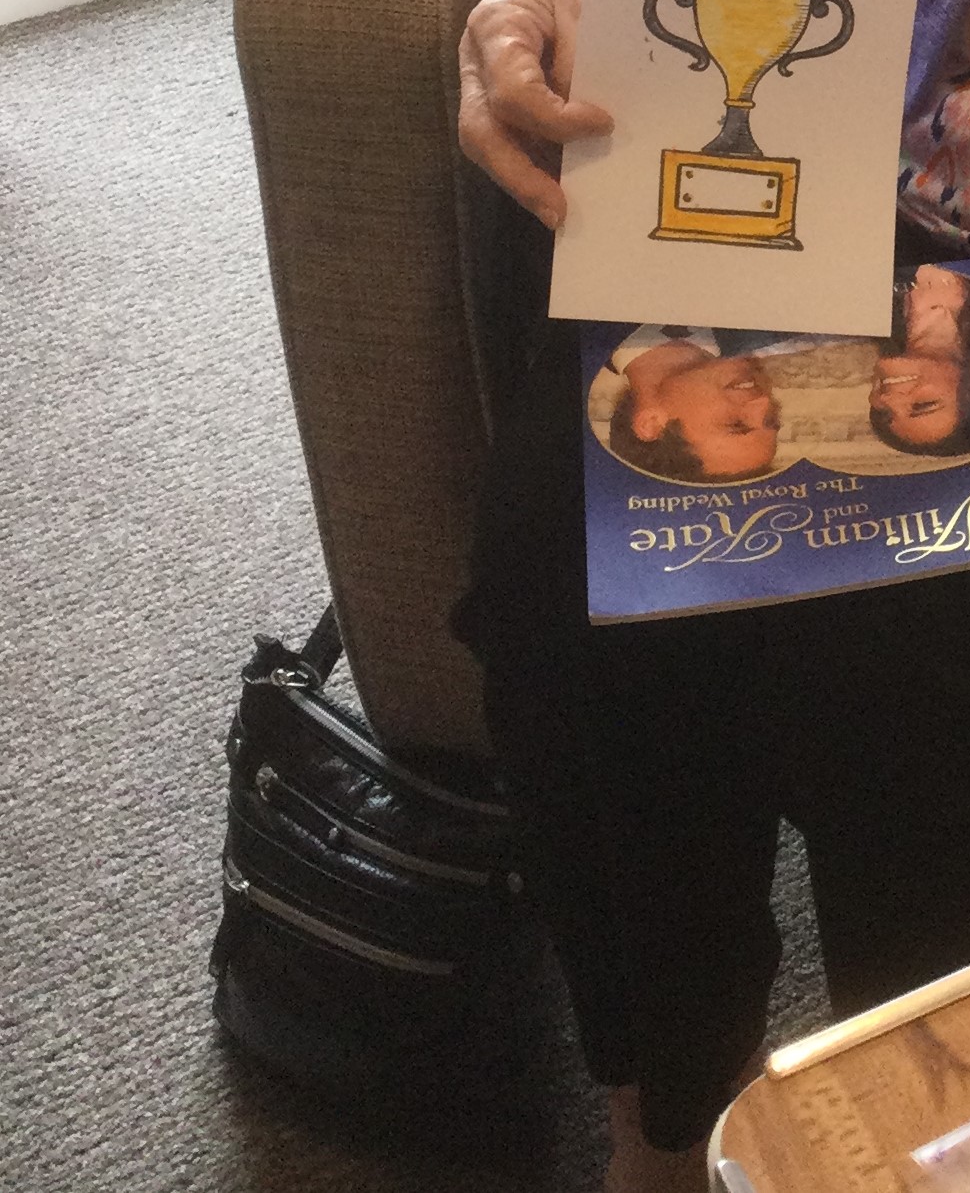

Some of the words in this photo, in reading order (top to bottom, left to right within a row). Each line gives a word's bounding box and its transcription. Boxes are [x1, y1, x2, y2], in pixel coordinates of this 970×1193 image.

[741, 483, 808, 506] Royal
[816, 476, 864, 494] The
[627, 492, 734, 512] Wedding
[824, 502, 868, 524] and
[629, 503, 814, 572] Kate
